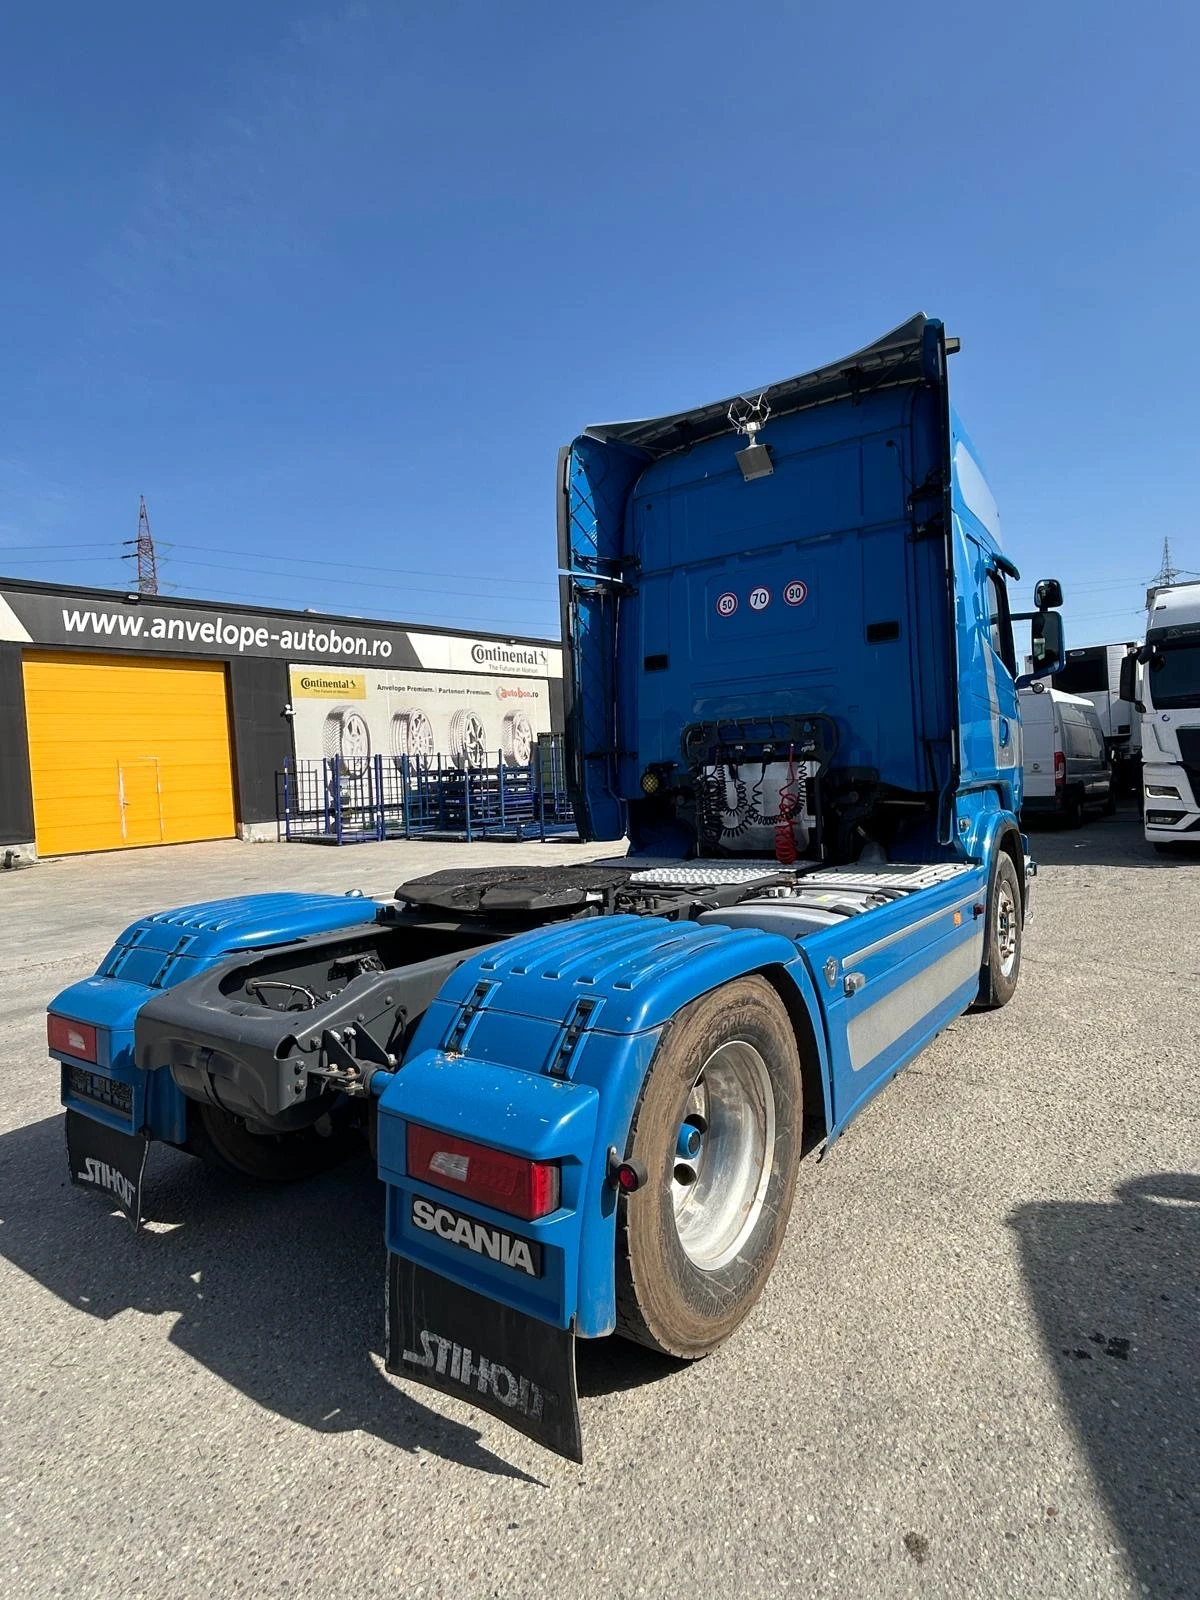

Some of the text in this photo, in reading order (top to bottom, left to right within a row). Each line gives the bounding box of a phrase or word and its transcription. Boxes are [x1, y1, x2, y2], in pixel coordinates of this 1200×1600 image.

[752, 592, 767, 606] 70
[789, 587, 801, 599] 90
[722, 599, 733, 610] 50
[62, 609, 392, 658] www.anvelope-autobon.ro
[471, 644, 538, 665] Continental
[300, 677, 349, 690] Continental
[377, 684, 406, 692] Anvelope
[412, 1199, 536, 1277] SCANIA
